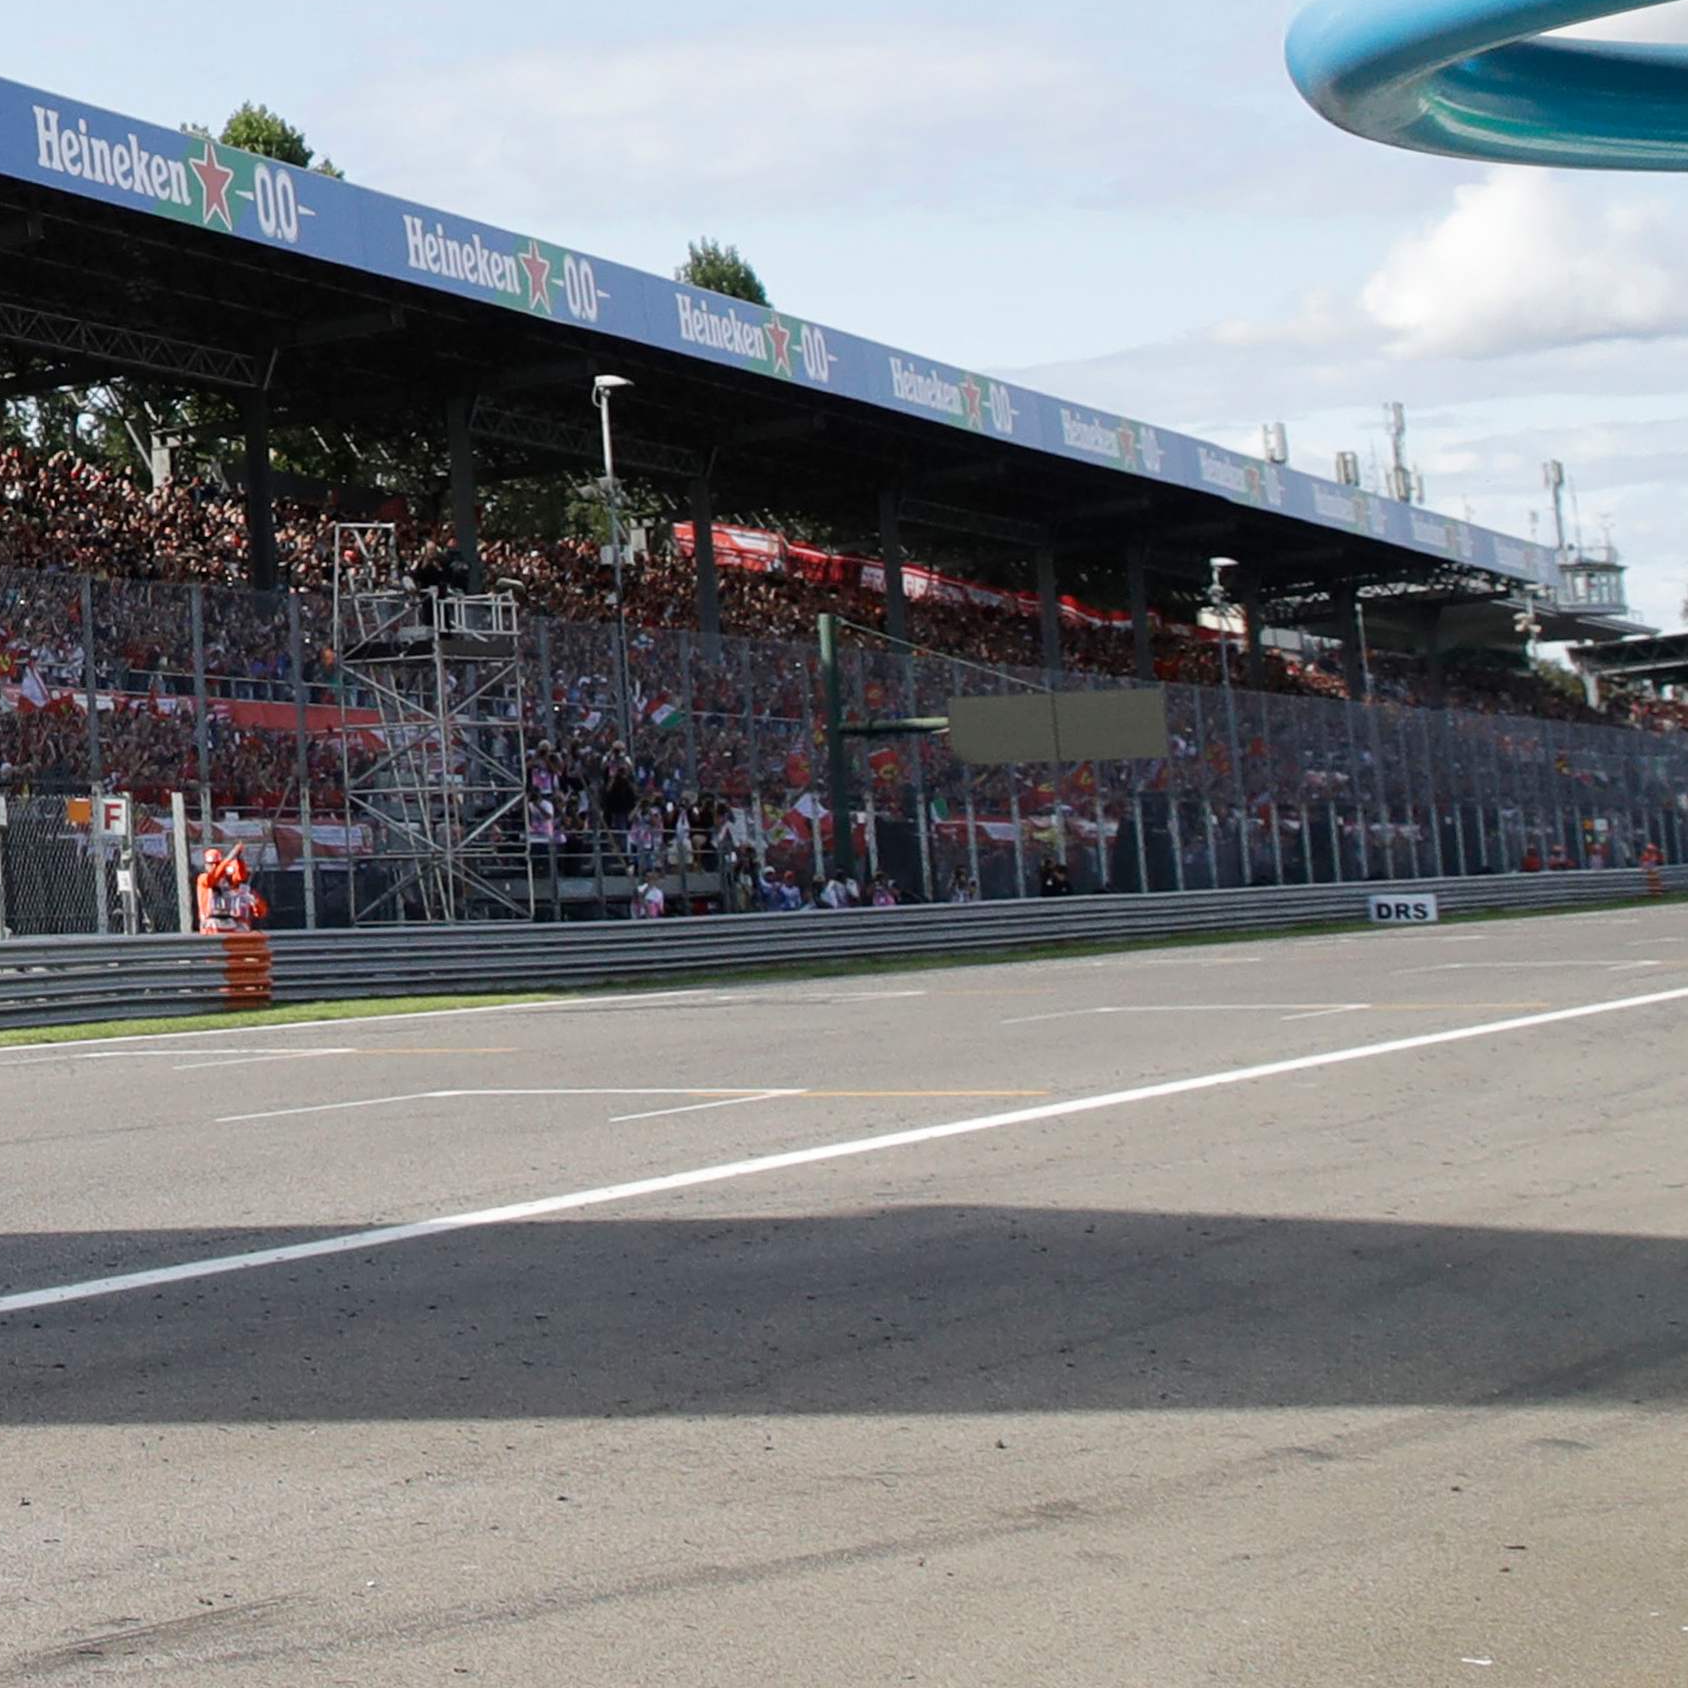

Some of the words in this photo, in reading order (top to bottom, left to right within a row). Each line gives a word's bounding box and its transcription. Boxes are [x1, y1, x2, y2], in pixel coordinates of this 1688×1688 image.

[32, 105, 190, 206] Heineken
[402, 214, 520, 296] Heineken
[675, 292, 766, 360] Heineken
[890, 357, 961, 414] Heineken
[104, 803, 122, 830] F
[1376, 903, 1429, 920] DRS
